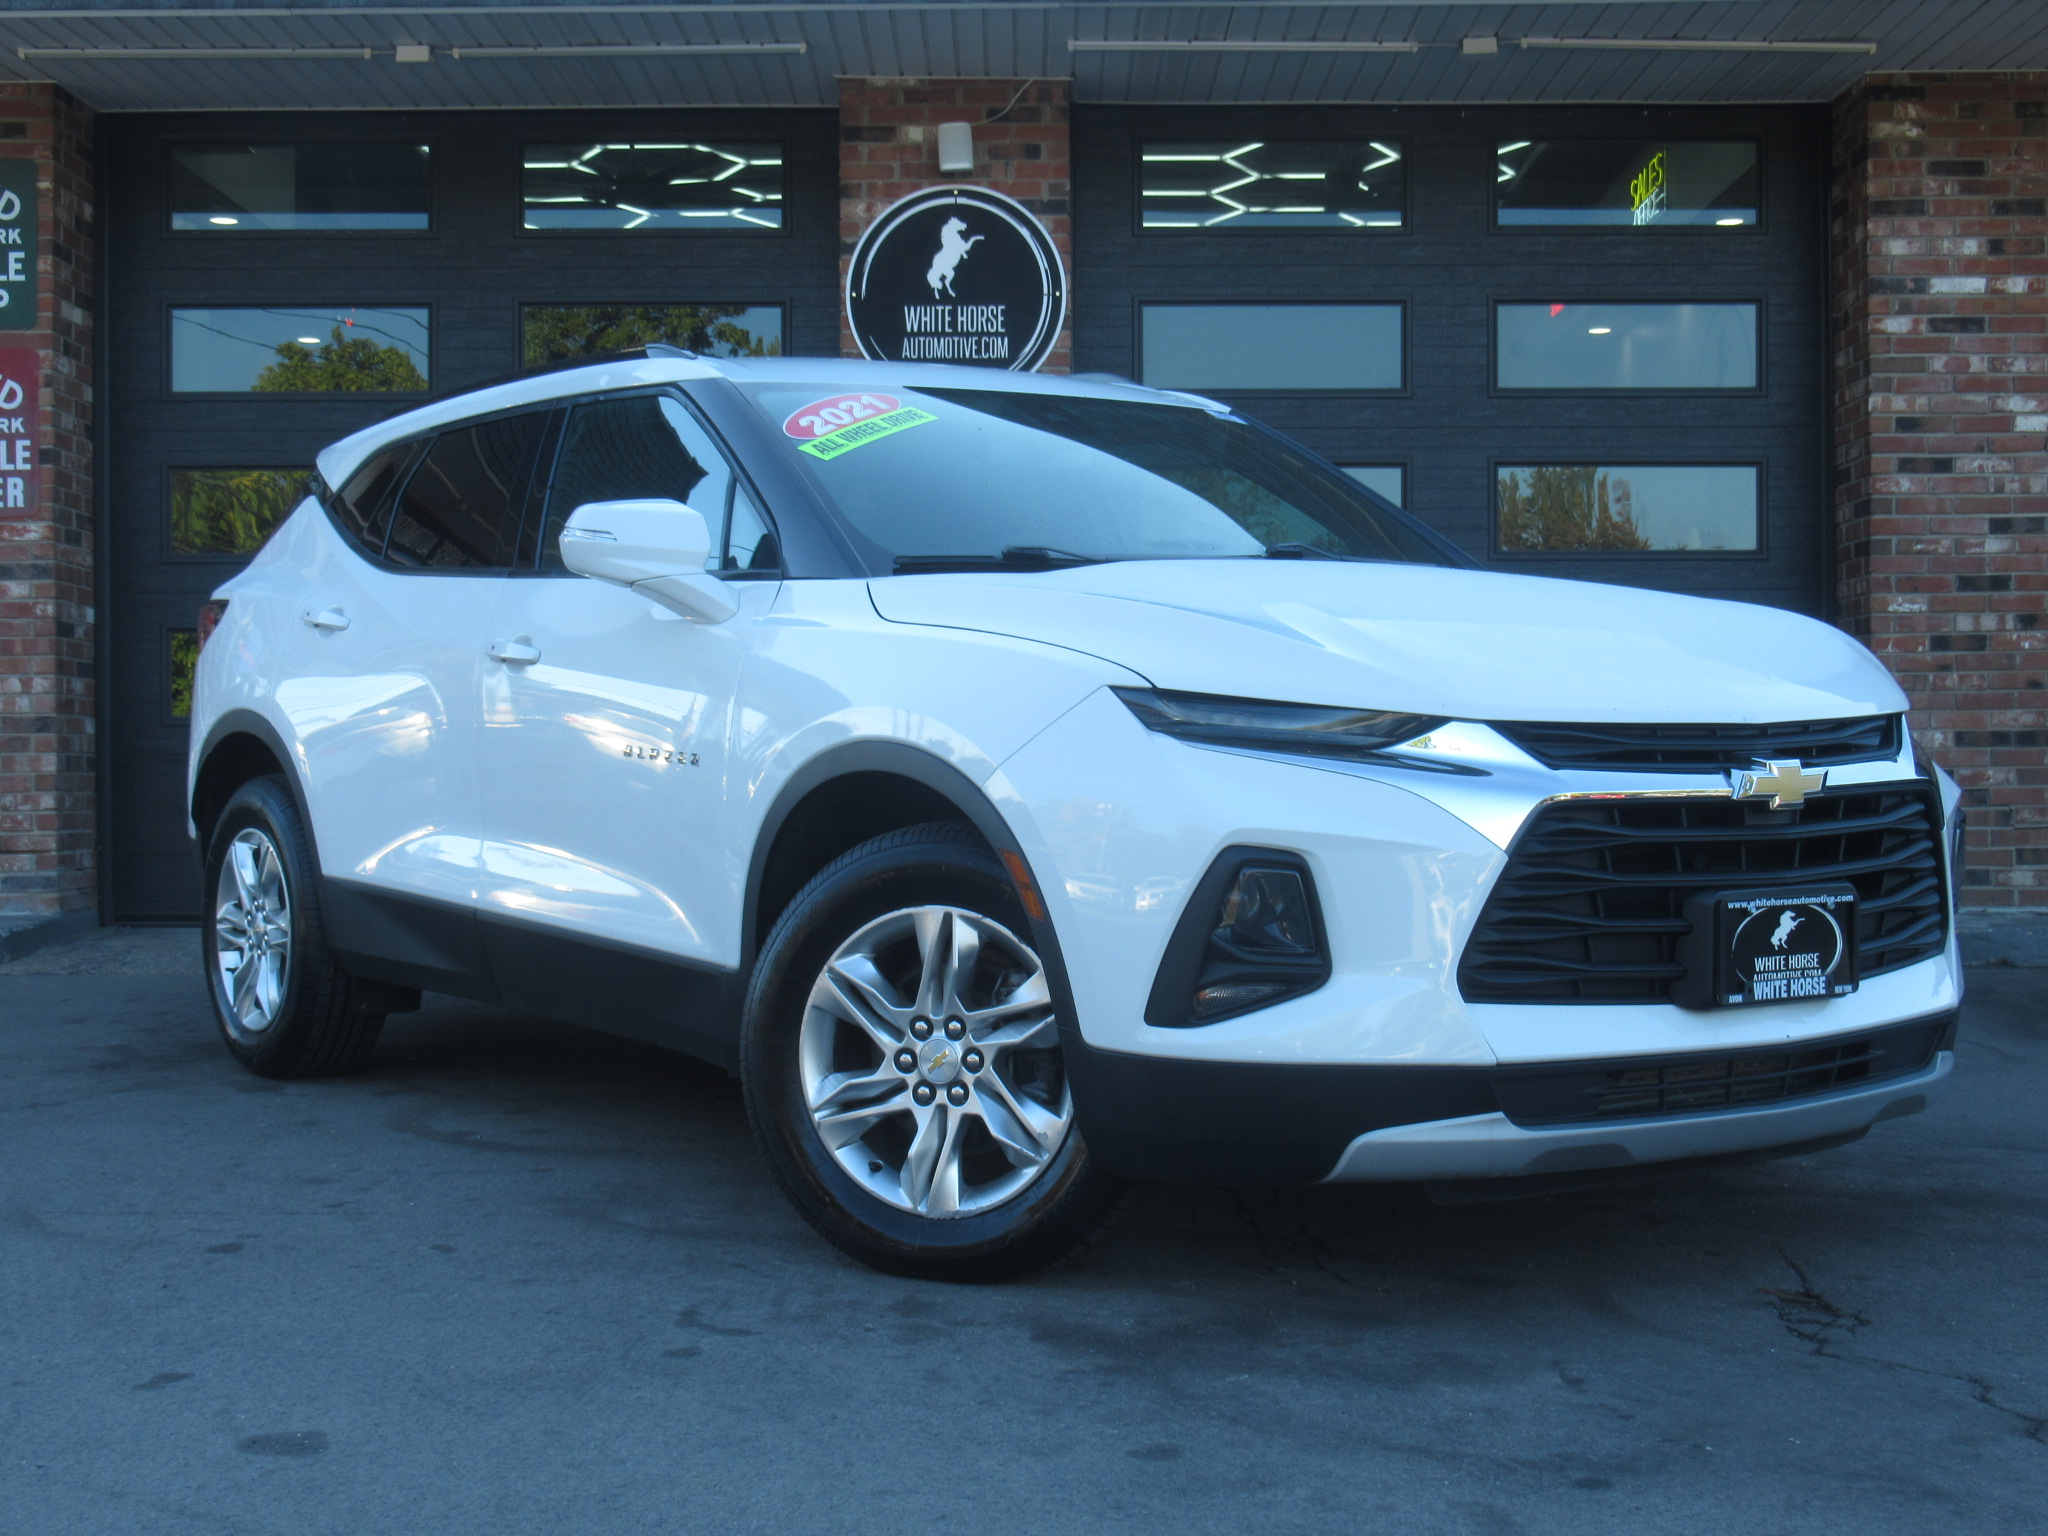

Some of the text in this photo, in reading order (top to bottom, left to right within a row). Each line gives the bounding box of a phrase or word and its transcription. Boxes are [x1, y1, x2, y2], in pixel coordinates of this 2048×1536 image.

[1630, 152, 1663, 211] SALES
[904, 305, 1006, 333] WHITE HORSE
[902, 336, 1009, 359] AUTOMOTIVE.COM
[798, 394, 891, 436] 2021
[811, 409, 927, 456] ALL WHEEL DRIVE
[623, 744, 700, 767] BLAZER
[1727, 894, 1854, 909] www.whitehorseautomotive.com
[1754, 953, 1820, 972] WHITE HORSE
[1728, 994, 1743, 1003] AVON
[1753, 976, 1826, 1001] WHITE HORSE
